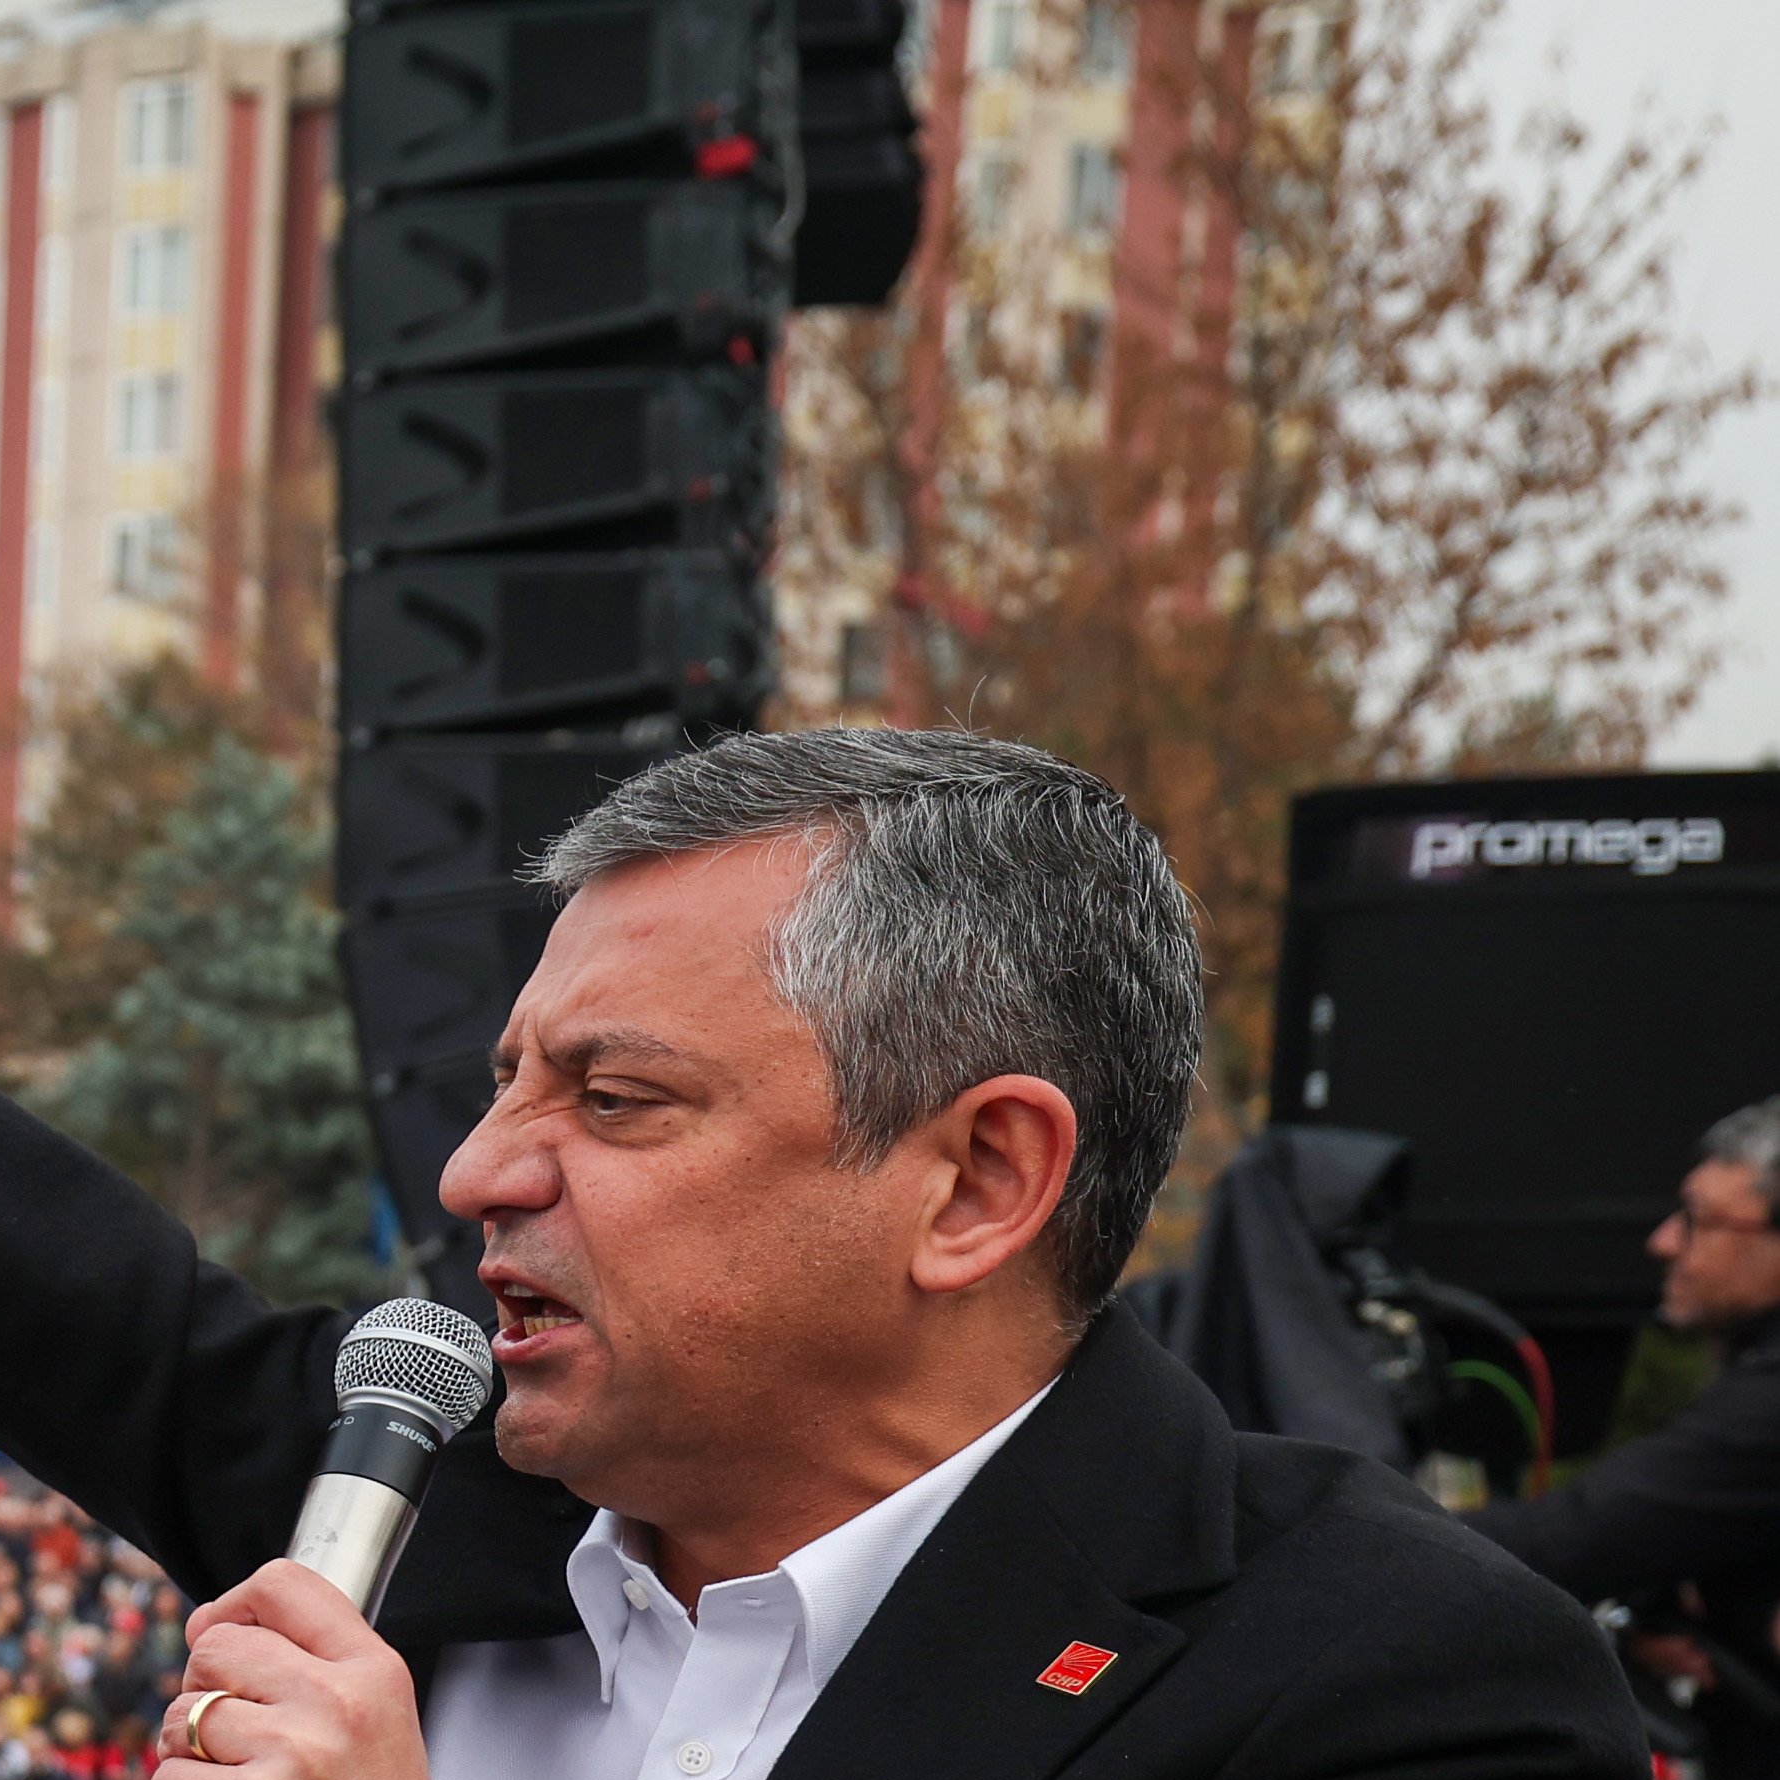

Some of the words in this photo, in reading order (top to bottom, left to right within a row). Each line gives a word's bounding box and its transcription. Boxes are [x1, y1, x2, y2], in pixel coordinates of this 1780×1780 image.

[1409, 817, 1726, 880] promega
[386, 1420, 436, 1453] SHURE
[1045, 1671, 1084, 1689] CHP
